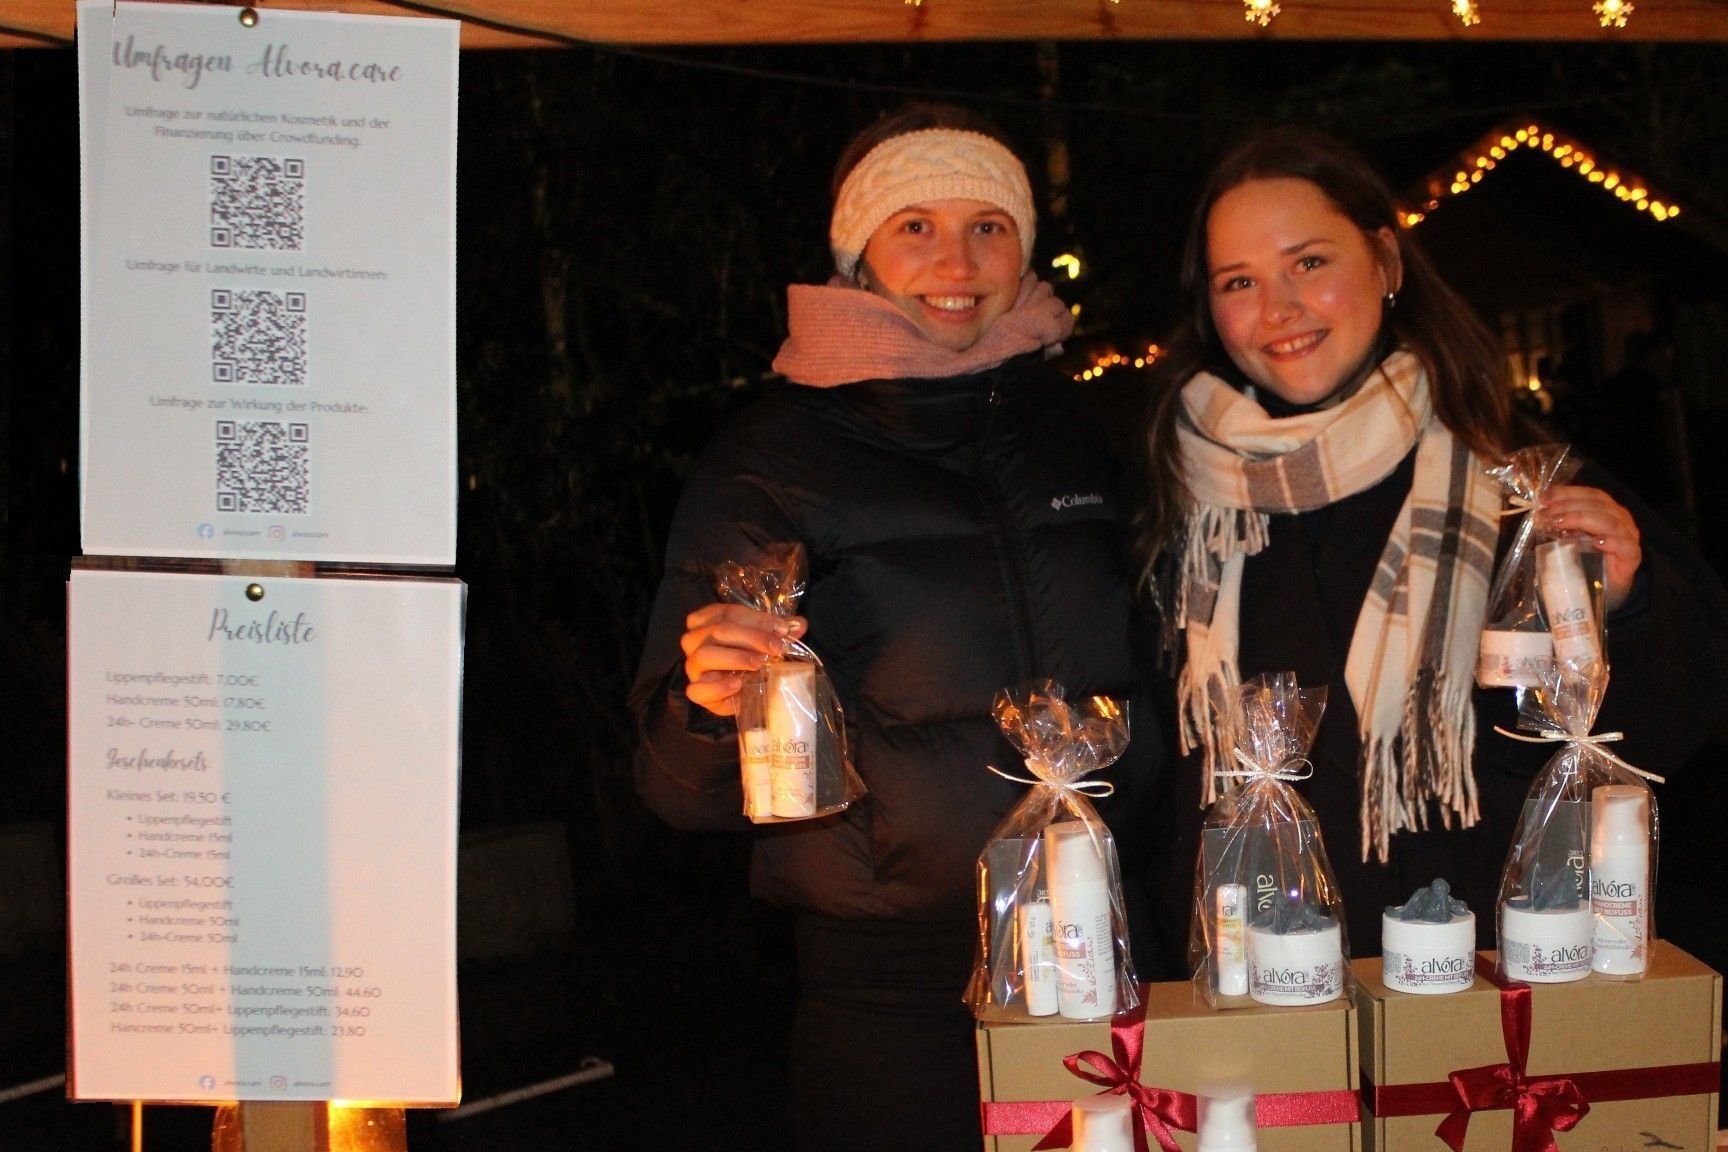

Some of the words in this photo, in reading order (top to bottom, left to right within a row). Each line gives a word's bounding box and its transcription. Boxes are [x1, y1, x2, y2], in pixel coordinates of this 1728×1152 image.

[113, 35, 234, 89] Umfragen
[124, 105, 181, 122] Umfrage
[183, 109, 205, 121] zur
[281, 112, 338, 127] Kosmetik
[341, 115, 366, 129] und
[368, 116, 391, 130] der
[154, 125, 233, 143] Finanzierung
[237, 128, 265, 142] über
[126, 258, 181, 275] Umfrage
[184, 259, 203, 273] für
[206, 262, 267, 277] Landwirte
[271, 265, 295, 278] und
[149, 395, 205, 411] Umfrage
[207, 399, 227, 411] zur
[230, 398, 283, 415] Wirkung
[286, 400, 307, 413] der
[1062, 493, 1104, 508] Columbia
[207, 607, 318, 645] Preisliste
[106, 693, 180, 709] Handcreme
[138, 717, 182, 732] Creme
[106, 789, 153, 803] Kleines
[220, 792, 233, 806] €
[137, 814, 233, 828] Lippenpflegestift
[137, 831, 205, 843] Handcreme
[106, 873, 154, 887] Großes
[137, 898, 233, 913] Lippenpflegestift
[138, 914, 206, 927] Handcreme
[207, 916, 241, 928] 50ml
[207, 932, 239, 945] 50ml
[109, 962, 133, 974] 24h
[135, 962, 178, 975] Creme
[223, 964, 296, 978] Handcreme
[110, 981, 134, 994] 24h
[135, 982, 178, 995] Creme
[181, 983, 215, 995] 50ml
[230, 984, 303, 998] Handcreme
[111, 1001, 135, 1014] 24h
[137, 1002, 179, 1015] Creme
